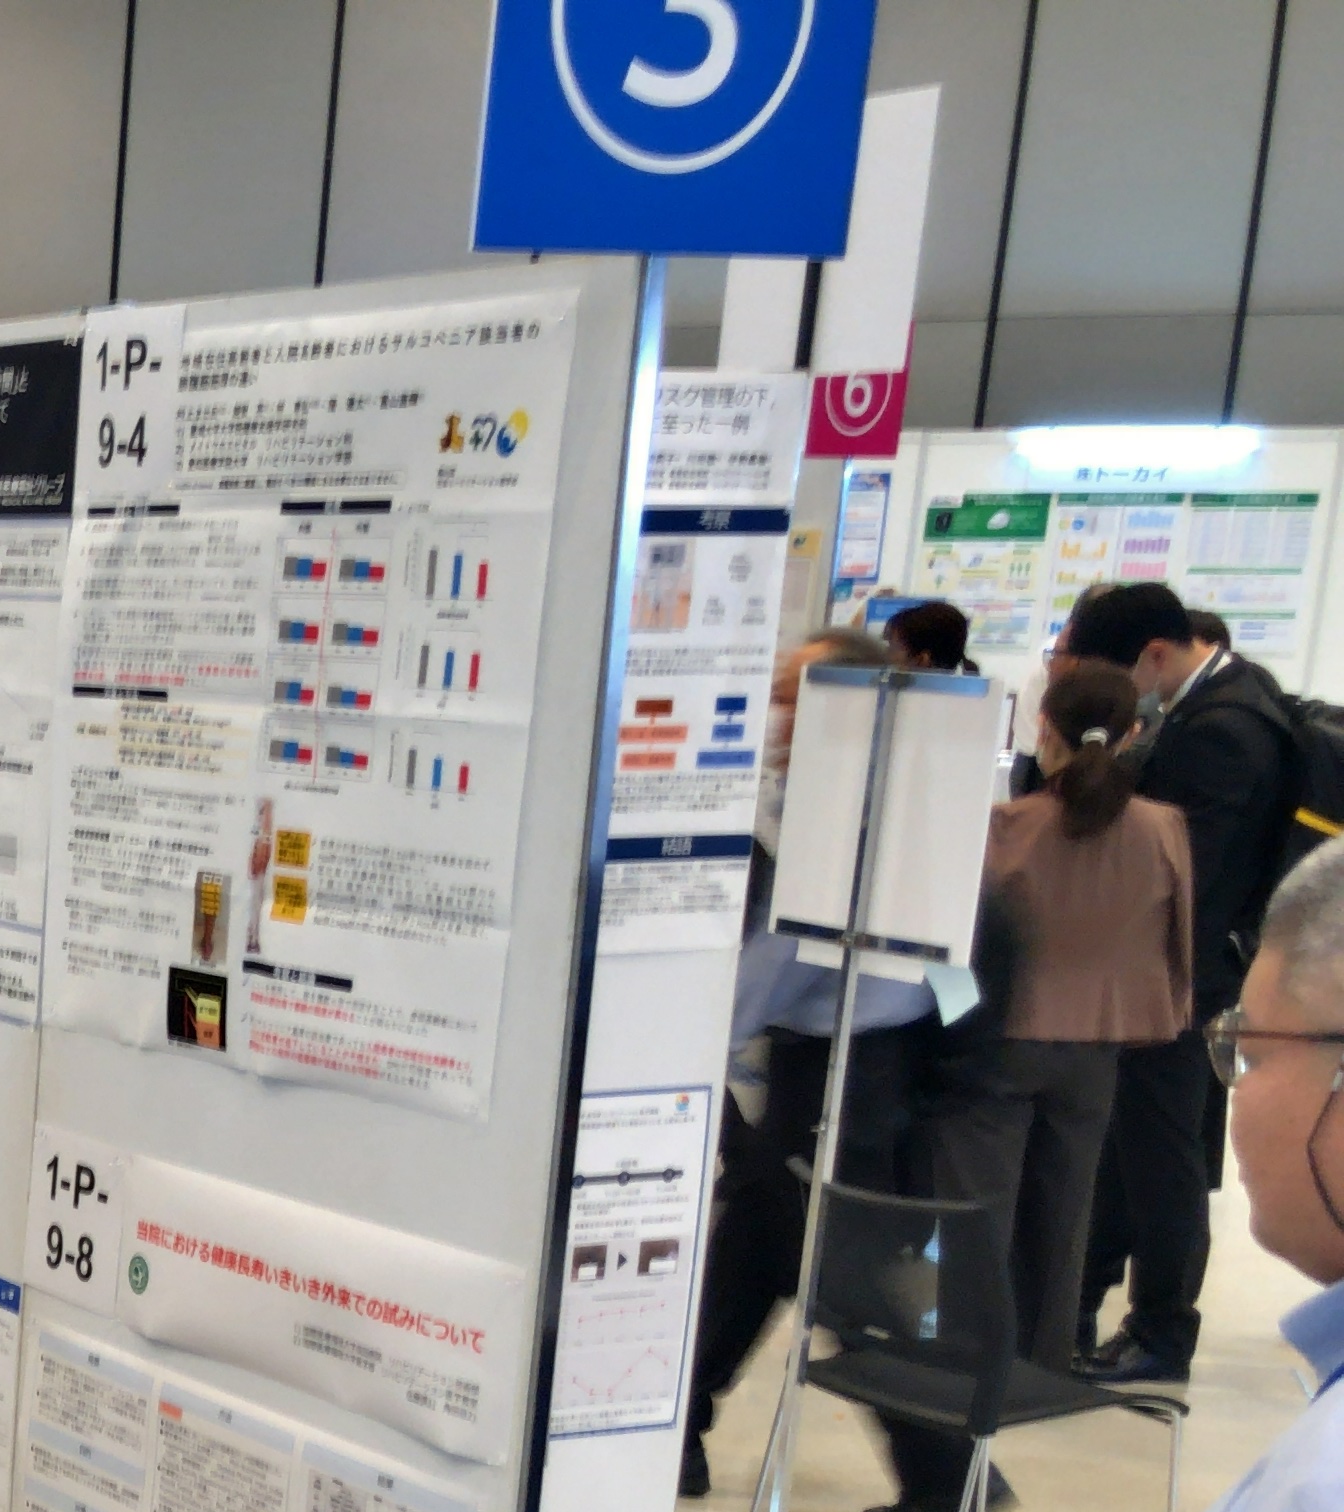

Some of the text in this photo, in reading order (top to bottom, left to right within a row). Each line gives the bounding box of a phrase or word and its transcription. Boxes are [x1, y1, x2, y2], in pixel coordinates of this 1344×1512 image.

[96, 336, 161, 391] 1-P-
[99, 411, 148, 468] 9-4
[45, 1153, 108, 1211] 1-P-
[44, 1222, 95, 1285] 9-8
[136, 1219, 486, 1354] 当院における健康長寿いきいき外来での試みについて
